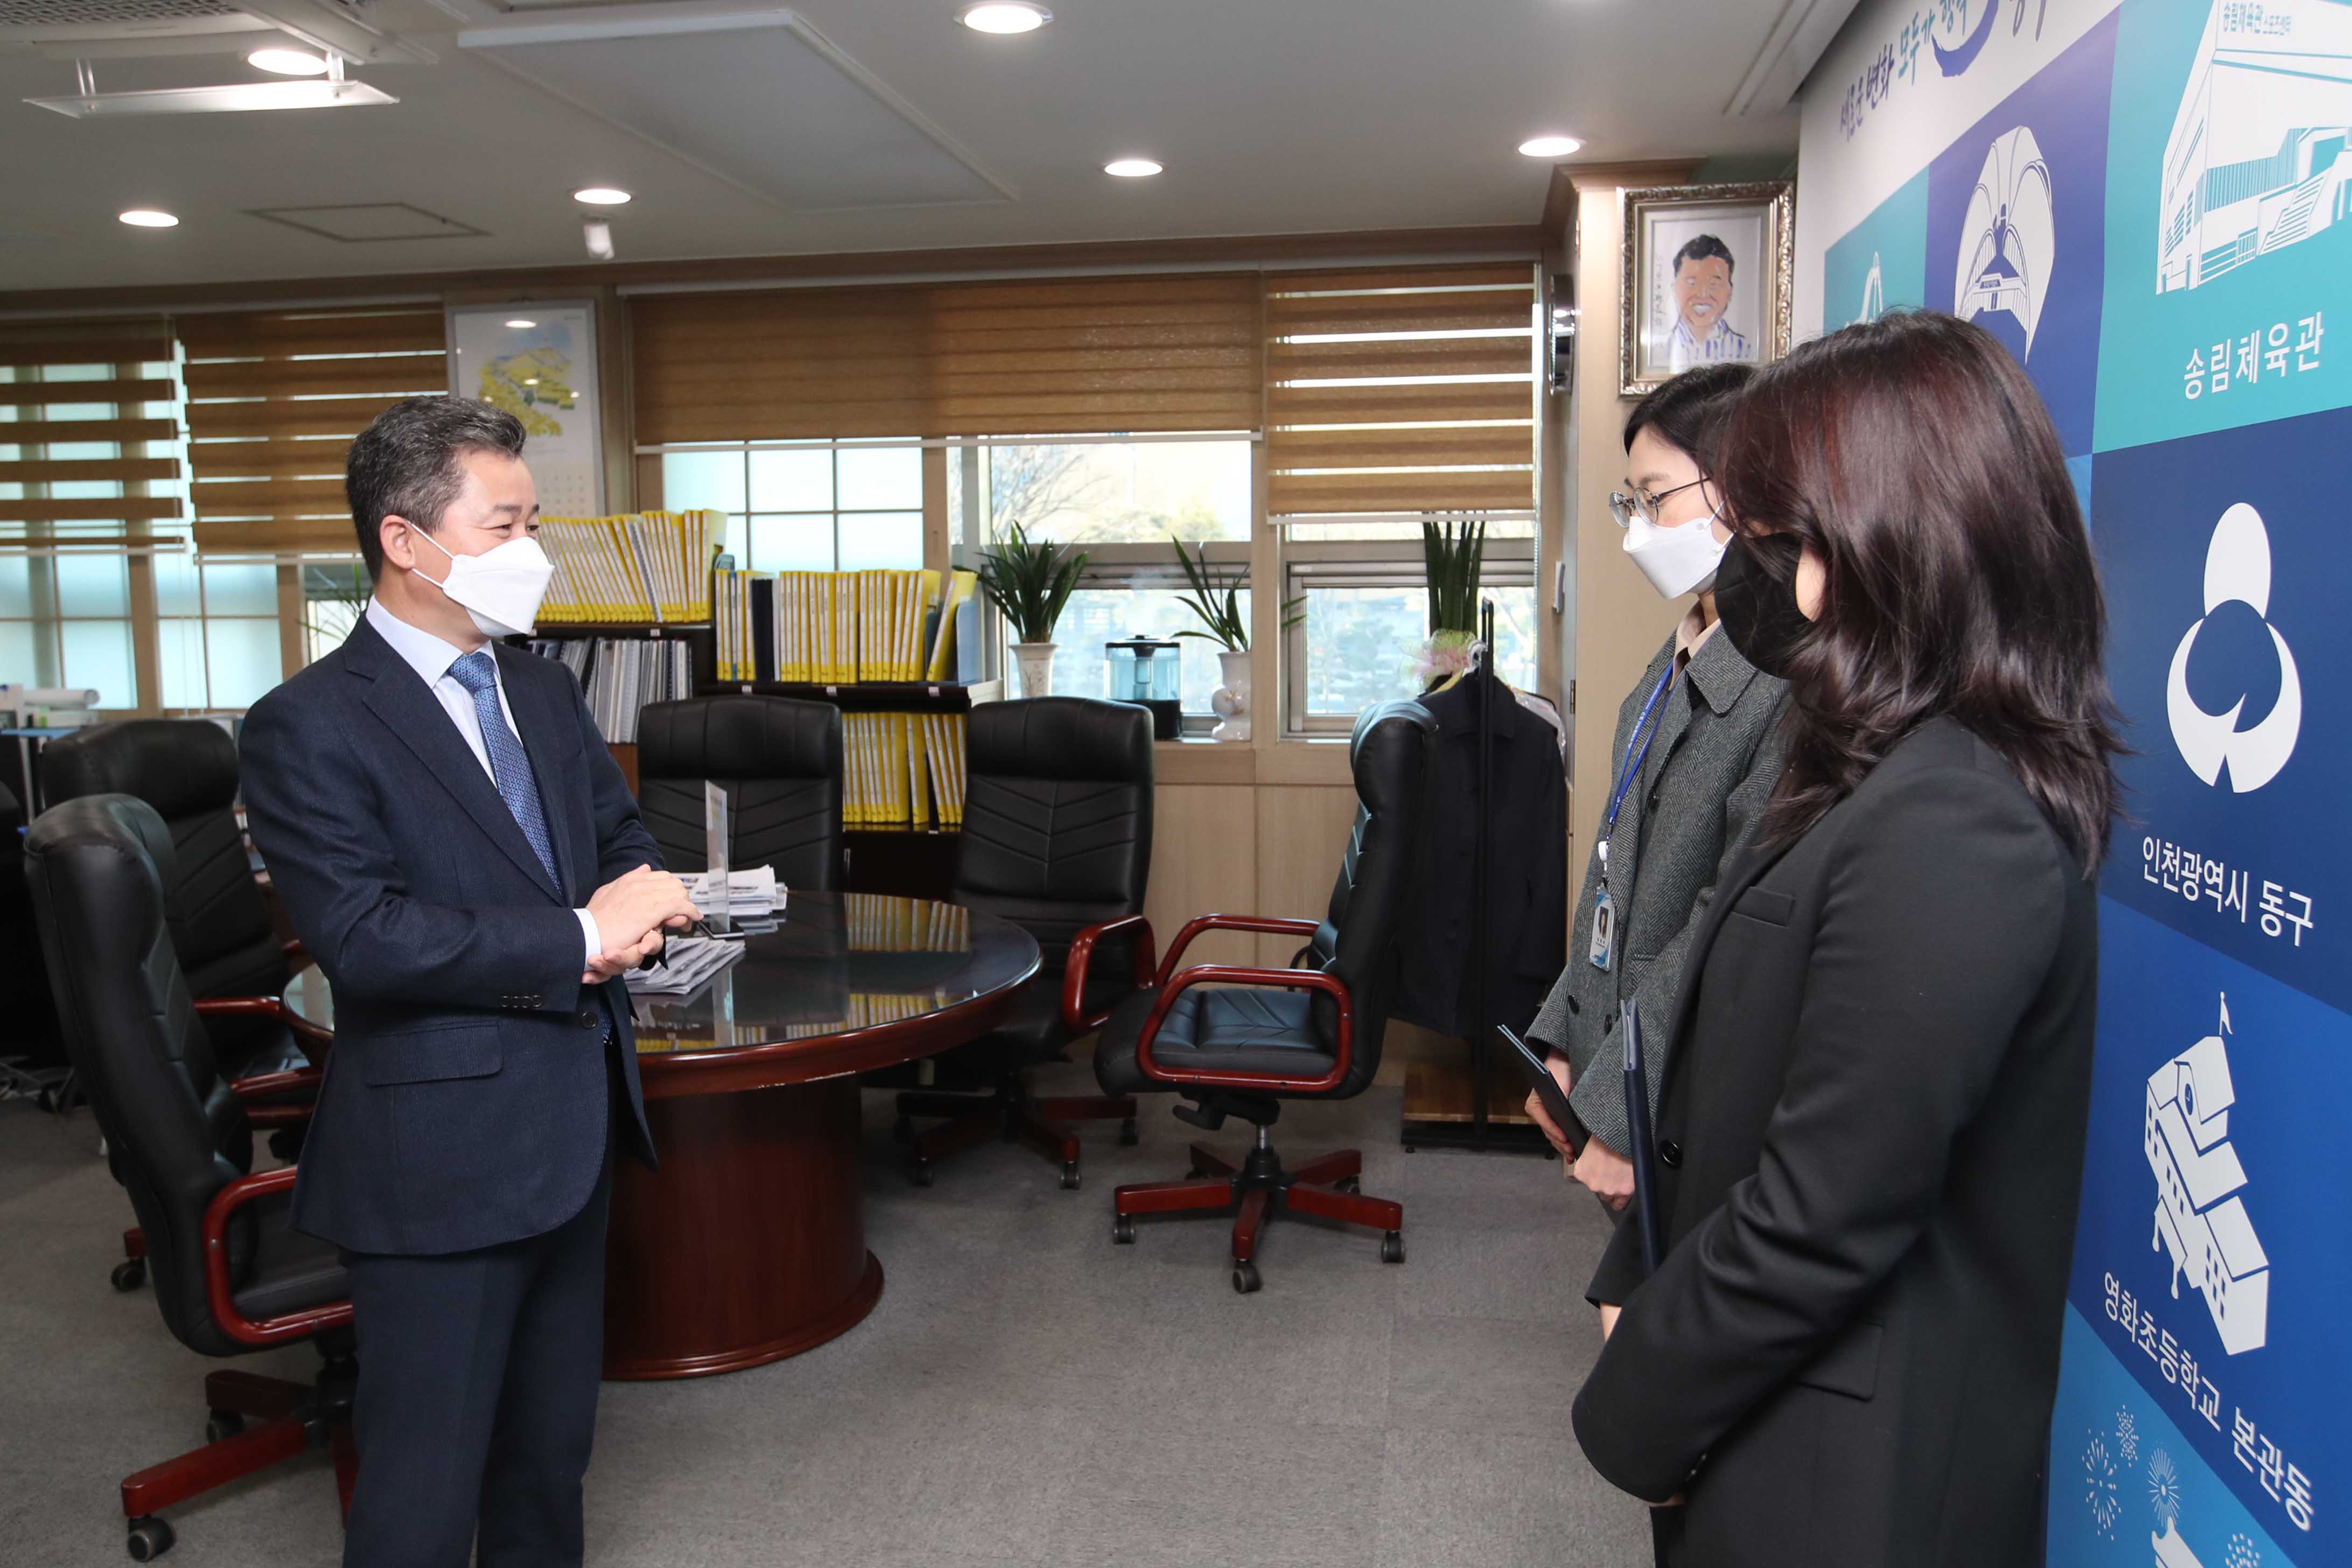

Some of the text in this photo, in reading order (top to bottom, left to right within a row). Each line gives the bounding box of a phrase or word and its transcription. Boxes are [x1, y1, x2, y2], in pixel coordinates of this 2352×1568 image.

[1866, 43, 1895, 110] 변화
[1898, 8, 1936, 87] 모두가
[2223, 2, 2263, 33] 송림체육관
[2183, 311, 2325, 400] 송림체육관
[2143, 836, 2314, 947] 인천광역시 동구
[2104, 1271, 2314, 1531] 영화초등학교 본관동
